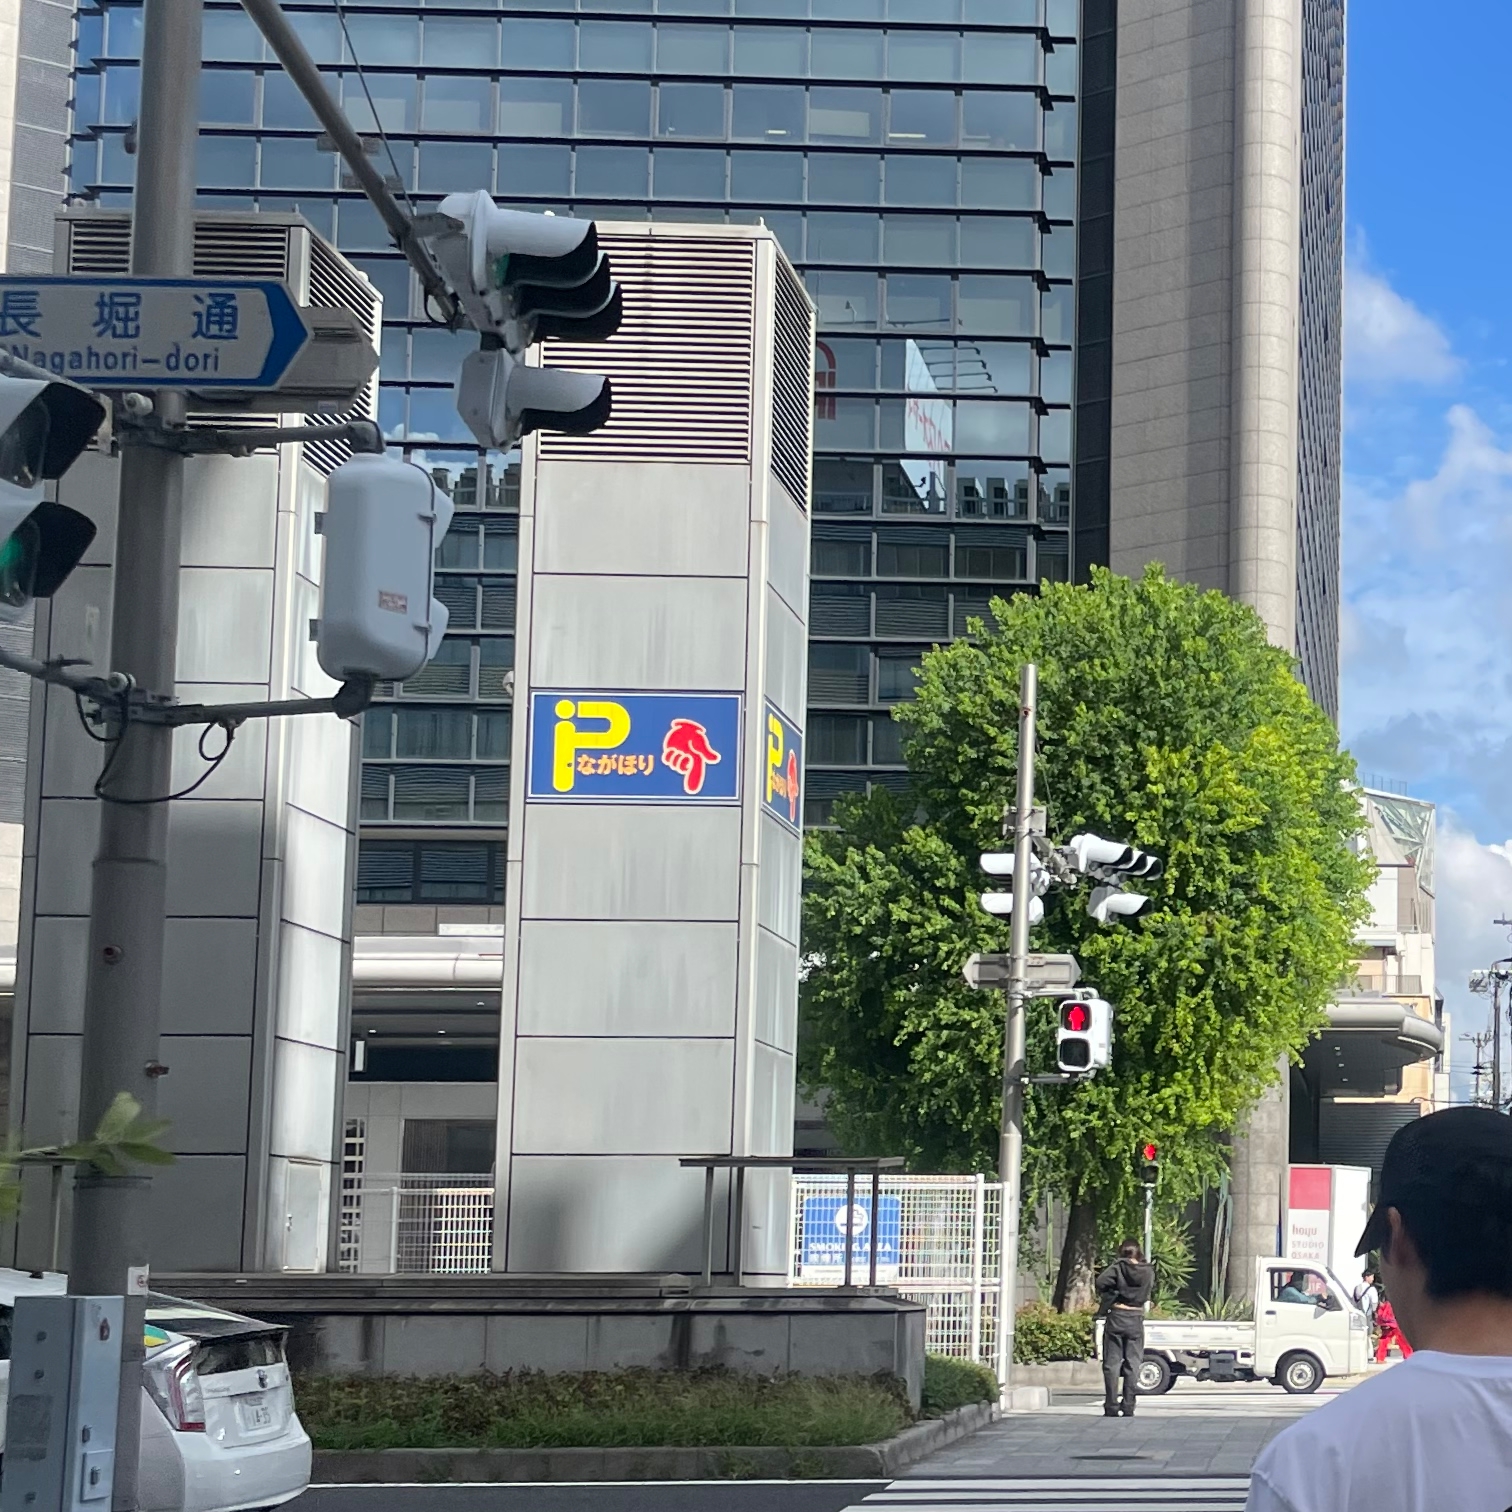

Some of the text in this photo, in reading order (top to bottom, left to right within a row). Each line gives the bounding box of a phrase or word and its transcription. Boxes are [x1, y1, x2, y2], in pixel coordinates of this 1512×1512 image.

[0, 291, 238, 340] 長堀通
[577, 754, 654, 775] ながほり
[1292, 1224, 1317, 1237] hoyu
[809, 1242, 860, 1251] SMOKIG
[1291, 1240, 1325, 1249] STUDIO
[1291, 1251, 1320, 1259] OSAKA
